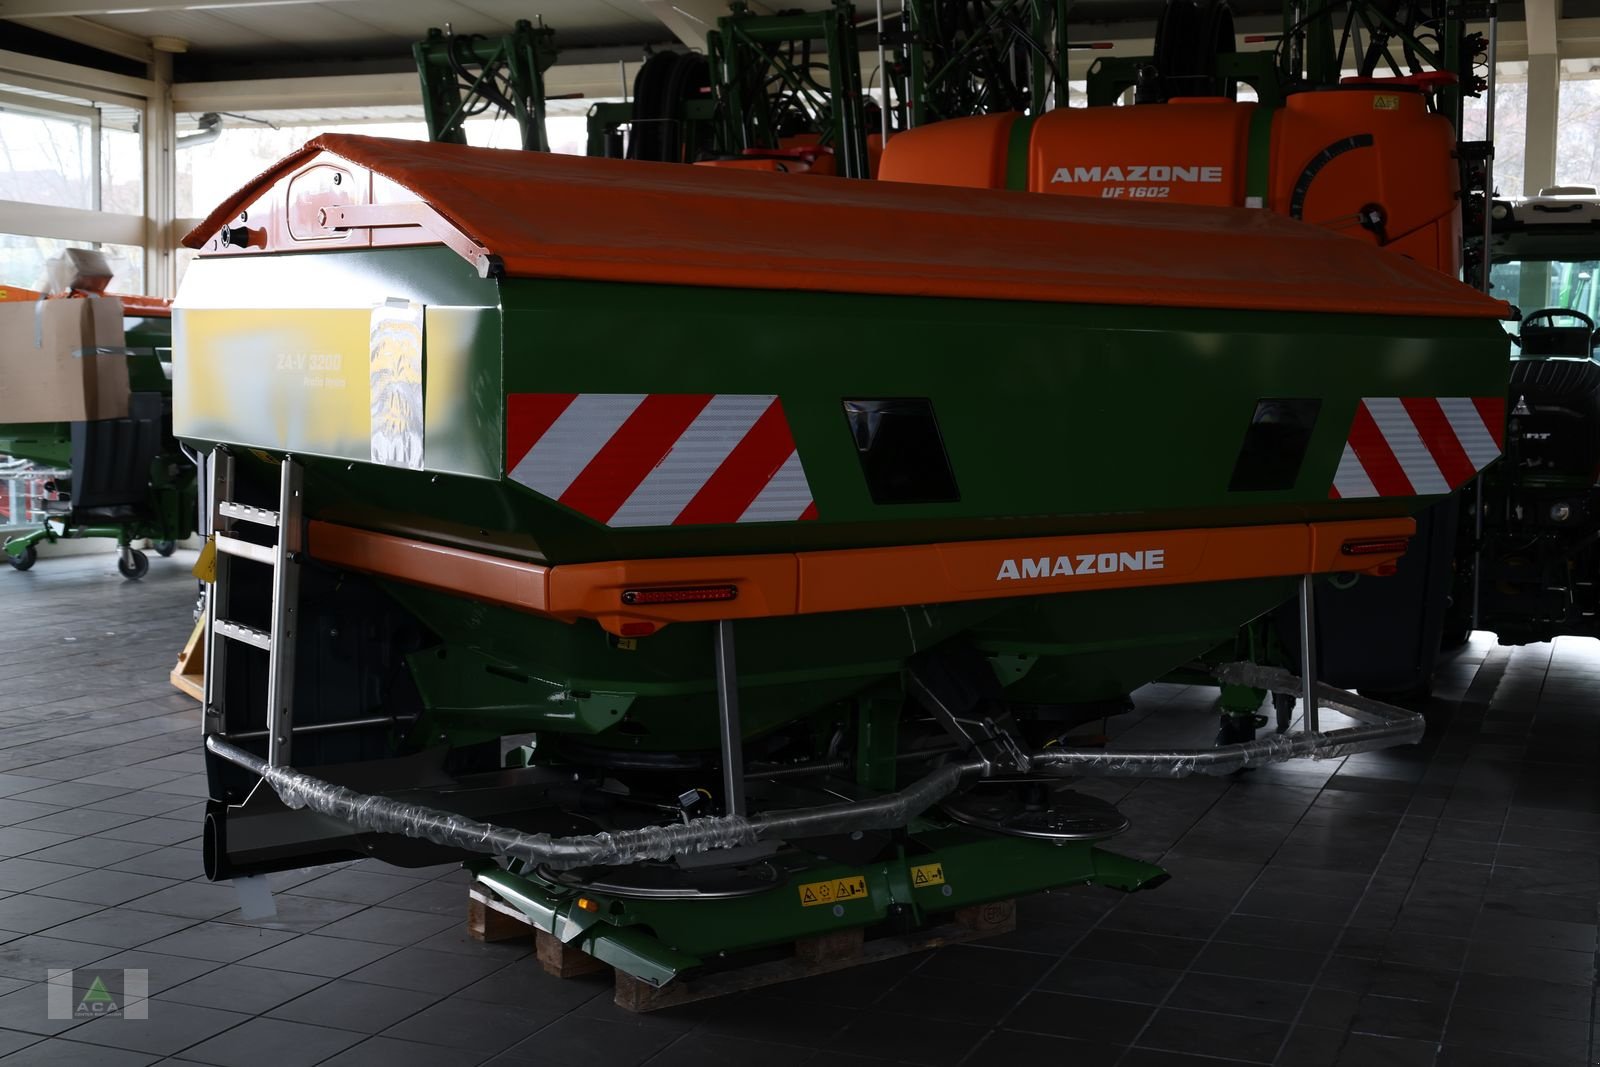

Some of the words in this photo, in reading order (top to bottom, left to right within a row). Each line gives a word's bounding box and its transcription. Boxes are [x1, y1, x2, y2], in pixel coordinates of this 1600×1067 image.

[1051, 165, 1223, 184] AMAZONE
[1102, 187, 1125, 198] UF
[1128, 187, 1170, 198] 1602
[996, 549, 1165, 581] AMAZONE
